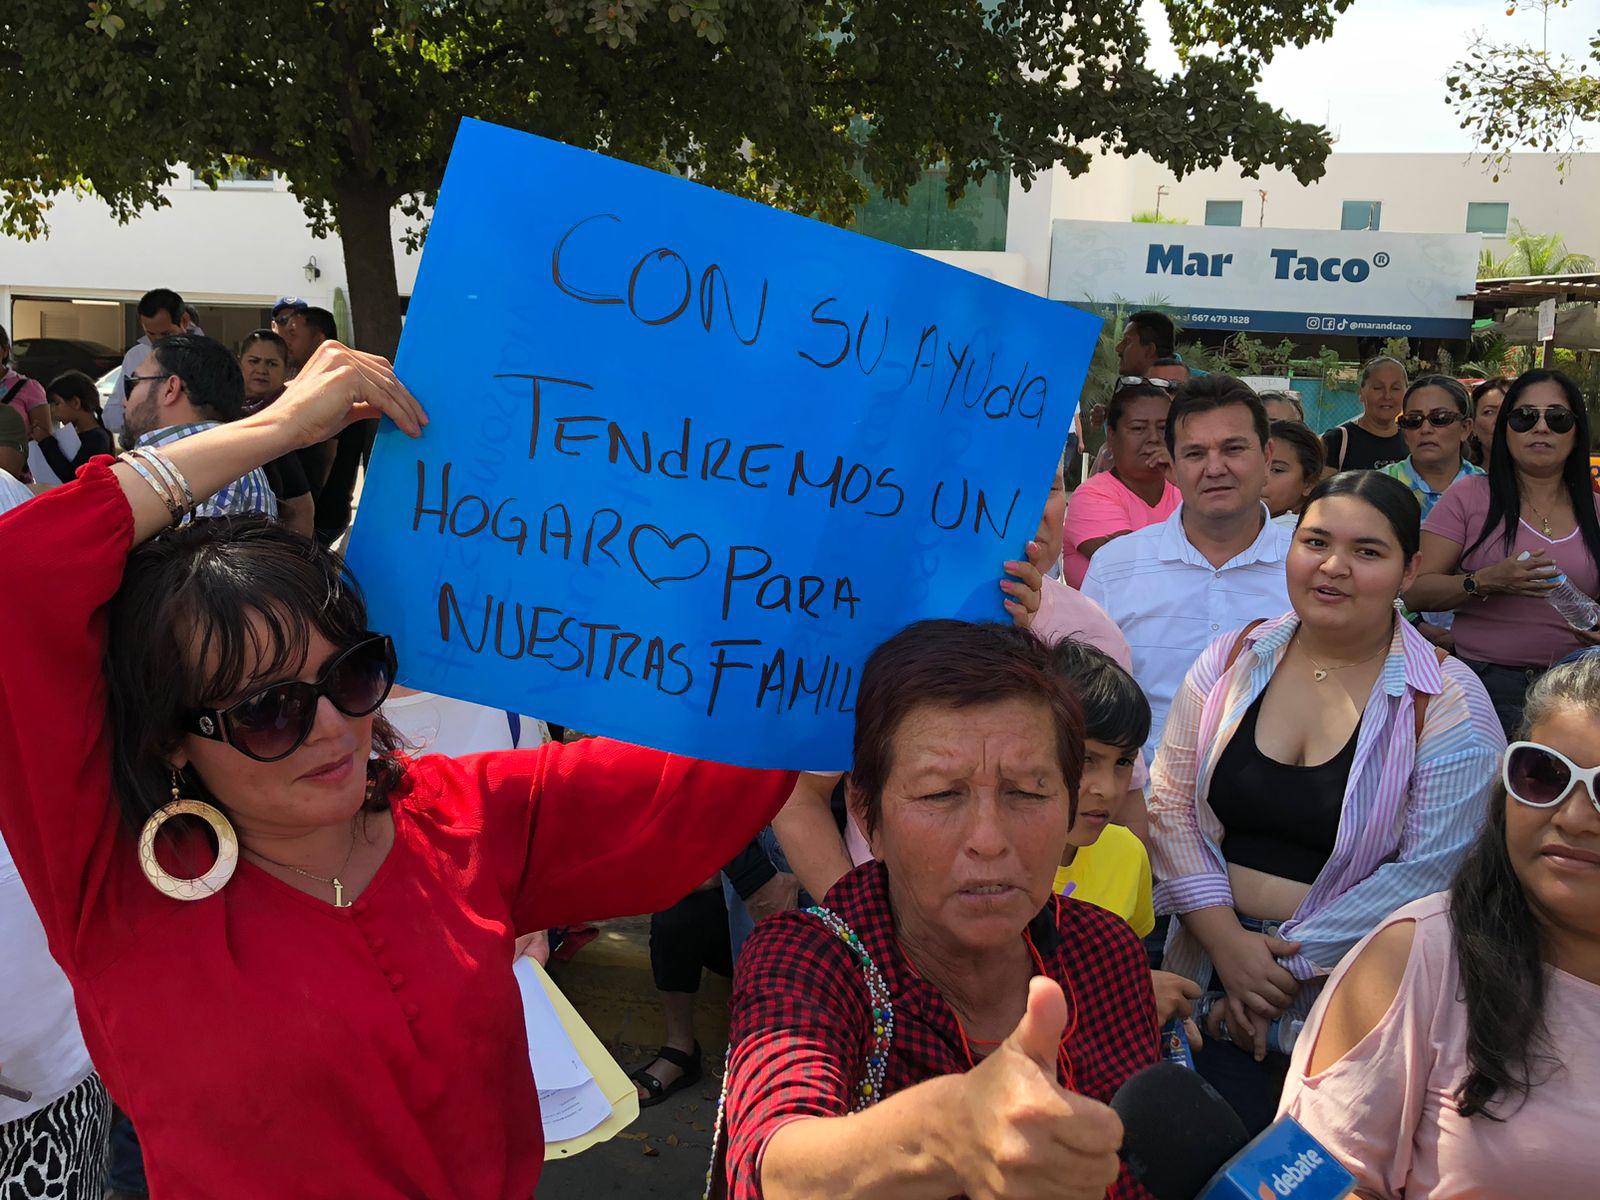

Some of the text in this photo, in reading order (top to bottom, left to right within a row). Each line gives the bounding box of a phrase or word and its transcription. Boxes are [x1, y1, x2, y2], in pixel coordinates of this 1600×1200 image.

[1145, 243, 1233, 277] Mar
[552, 212, 768, 346] CON
[797, 297, 888, 376] SU
[1191, 313, 1209, 322] 667
[1210, 314, 1228, 323] 479
[1229, 315, 1250, 324] 1528
[1349, 321, 1412, 331] @marandtaco
[412, 460, 623, 568] HOGAR
[930, 479, 1021, 540] UN
[437, 581, 857, 717] NUESTRAS FAMIL
[1271, 1149, 1324, 1196] debate
